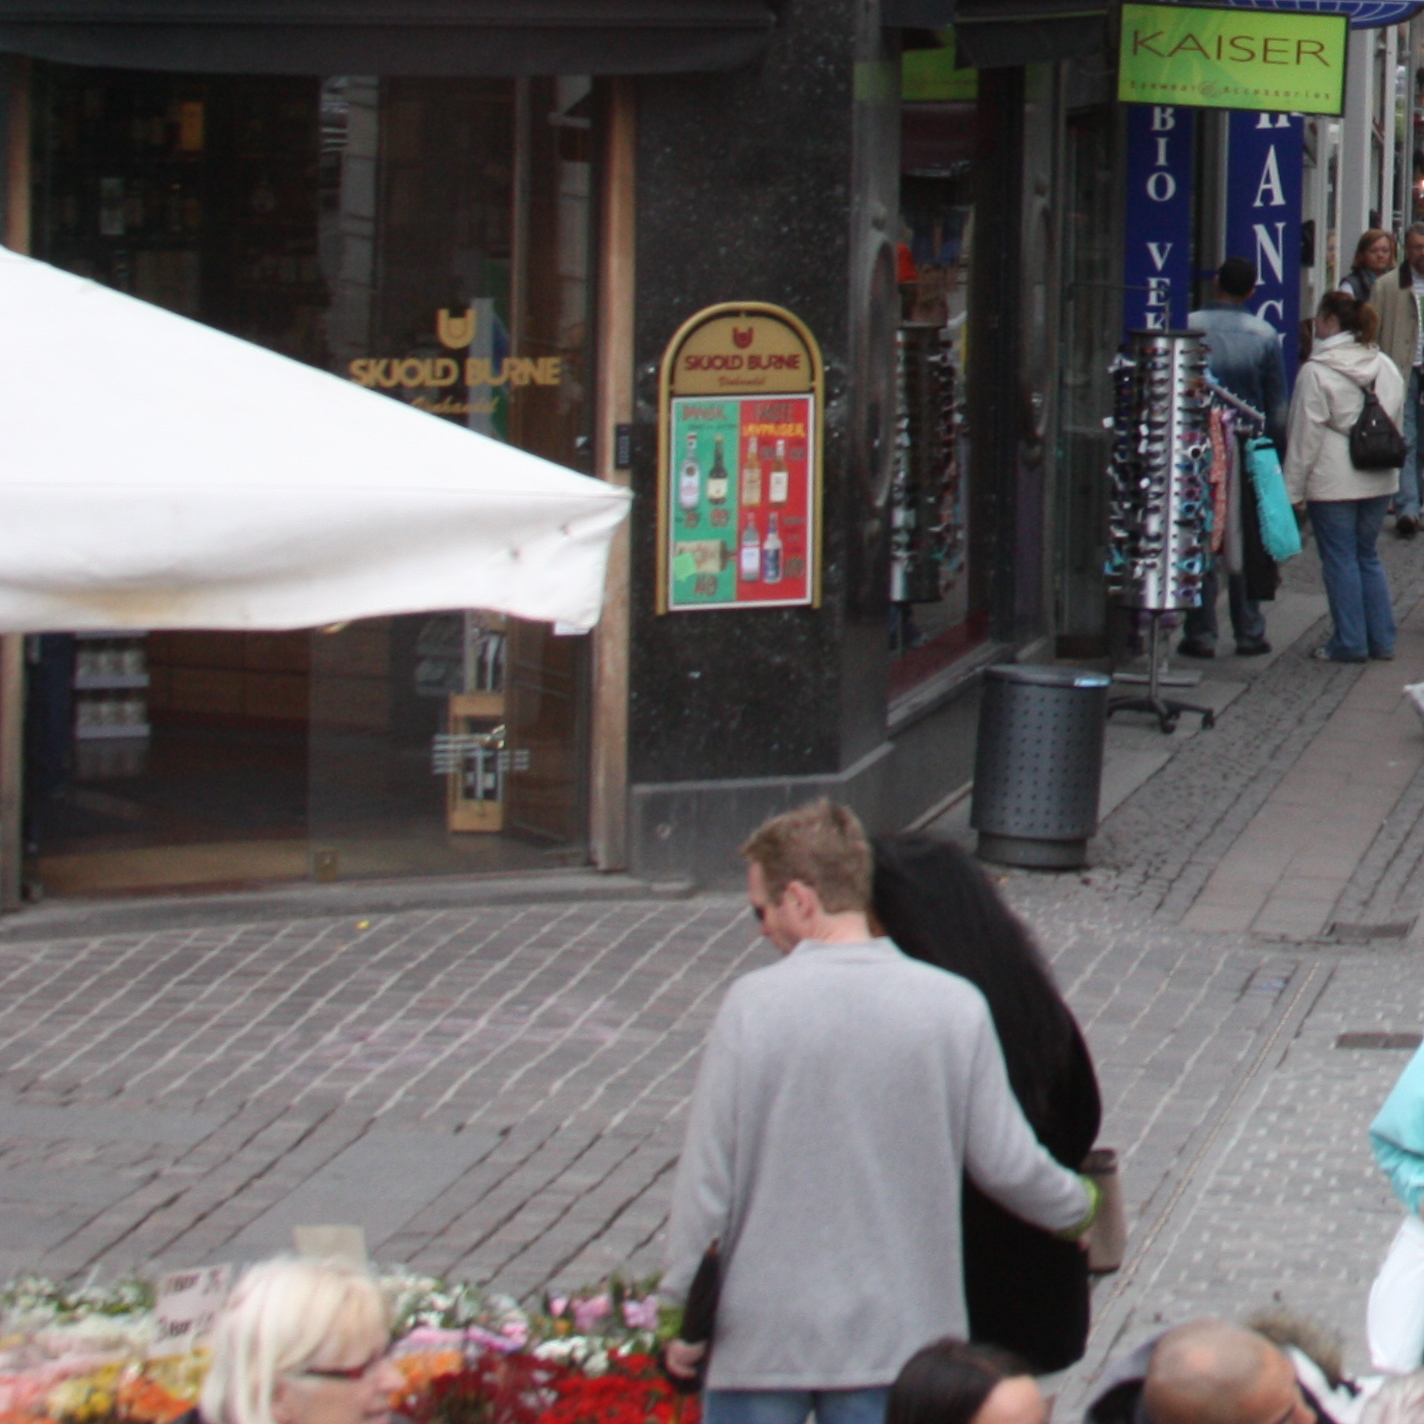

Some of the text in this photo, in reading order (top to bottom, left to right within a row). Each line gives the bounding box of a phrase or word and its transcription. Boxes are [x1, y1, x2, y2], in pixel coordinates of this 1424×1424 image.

[1132, 30, 1331, 67] KAISER
[1222, 86, 1331, 100] Accessories
[465, 356, 563, 386] BURNE
[747, 354, 801, 370] BURNE
